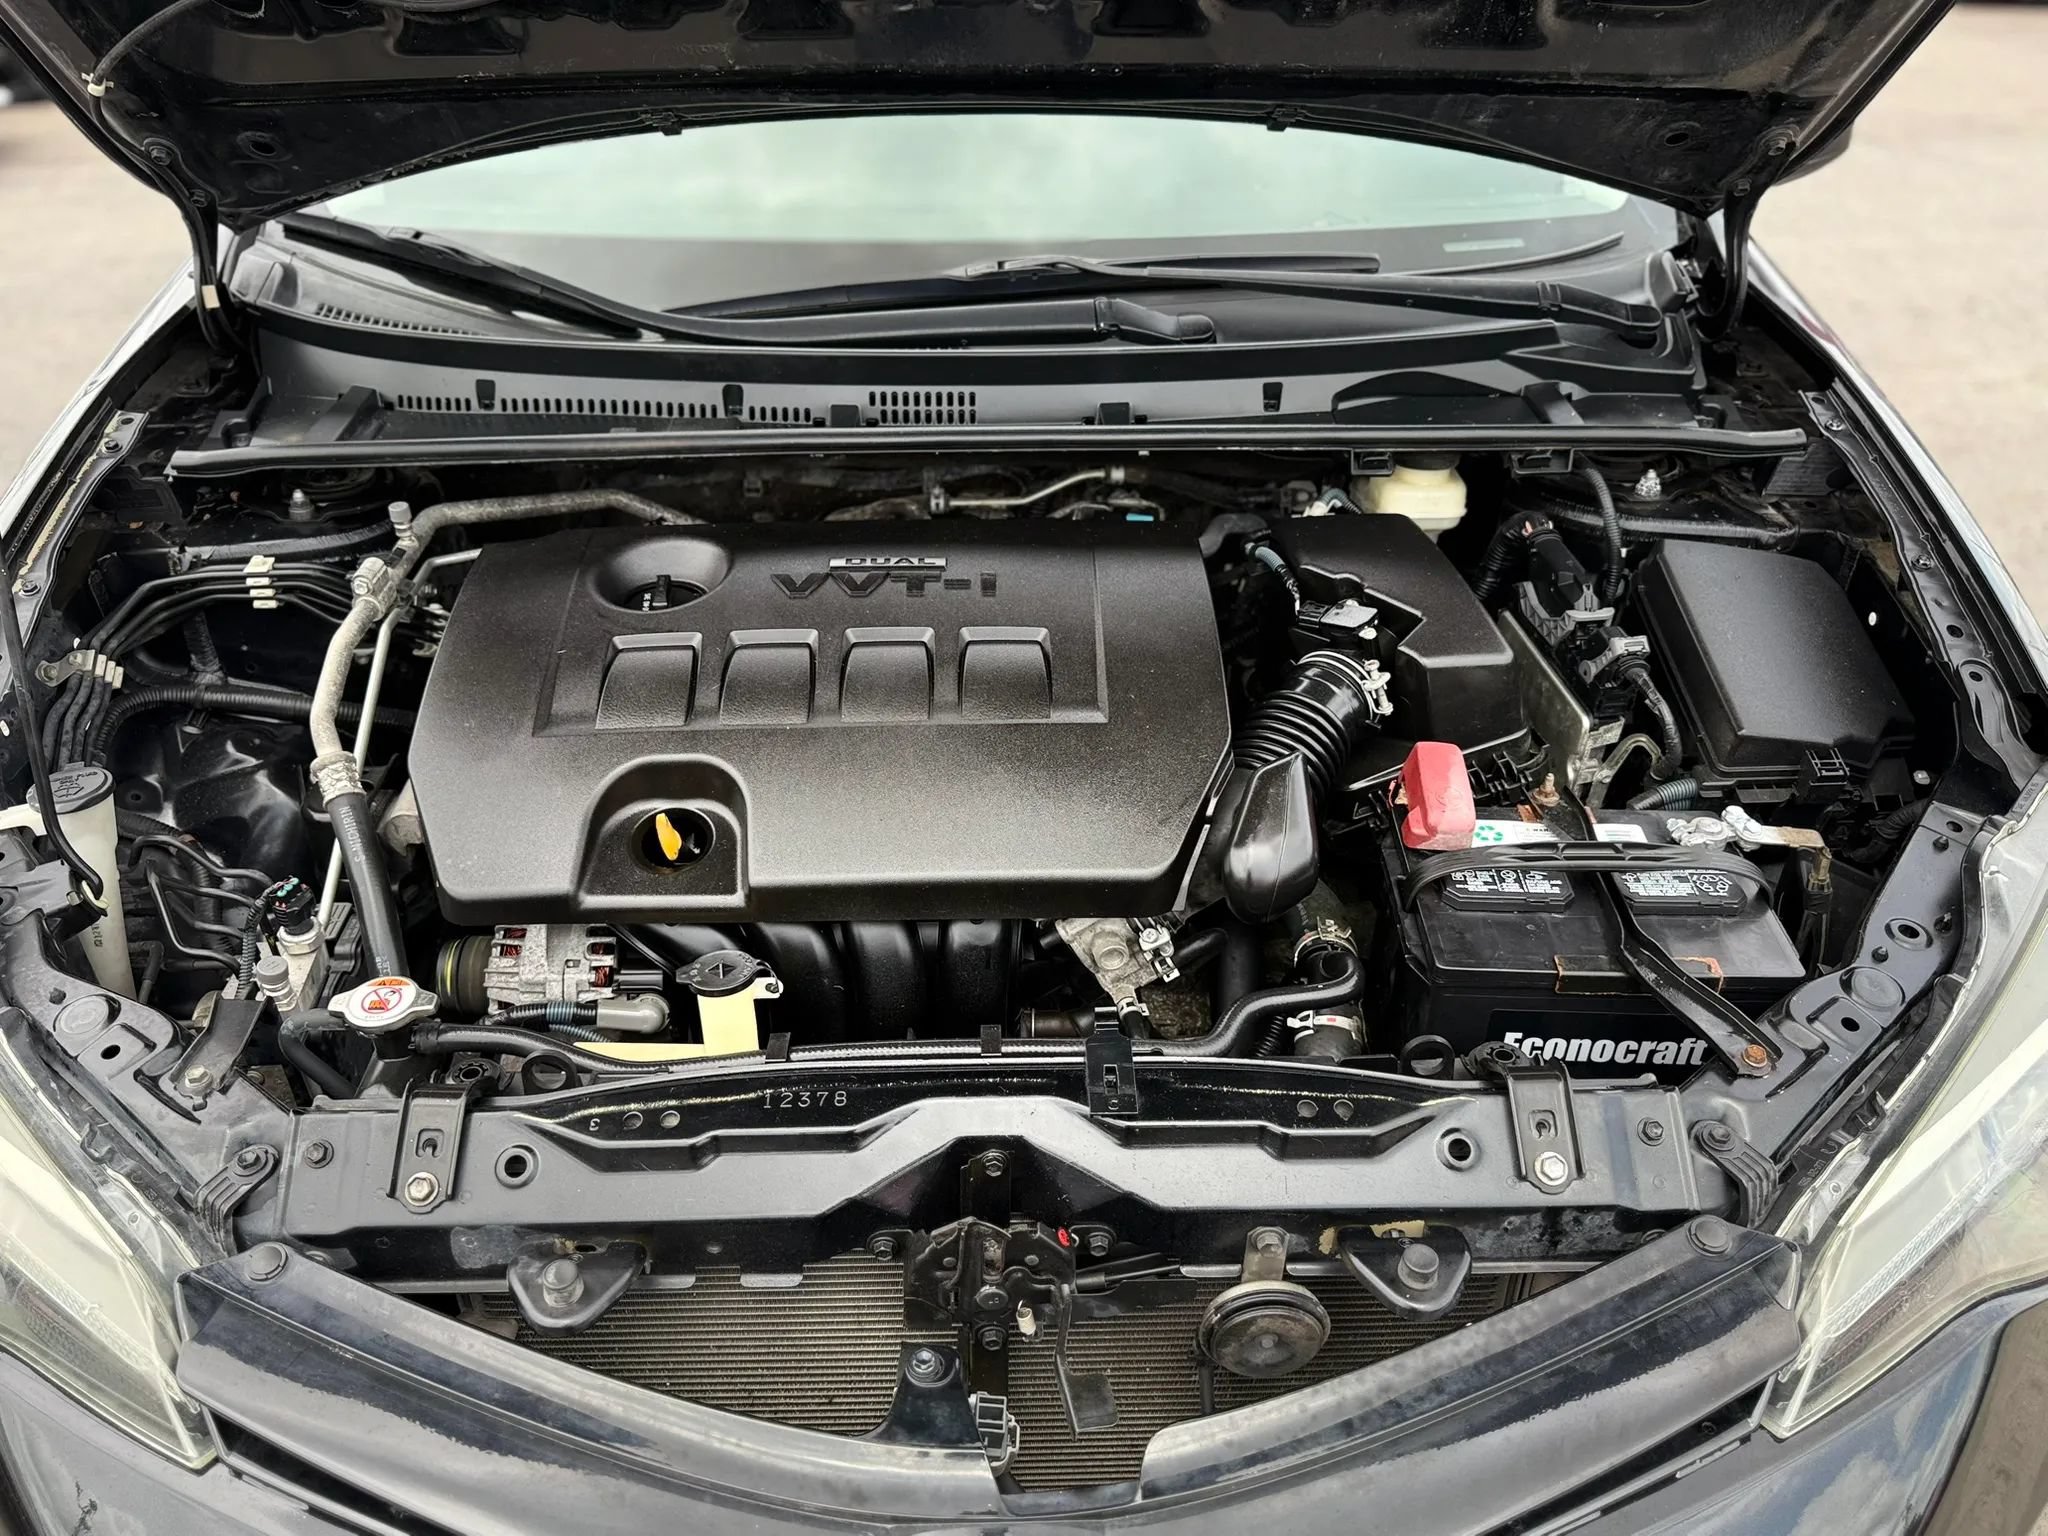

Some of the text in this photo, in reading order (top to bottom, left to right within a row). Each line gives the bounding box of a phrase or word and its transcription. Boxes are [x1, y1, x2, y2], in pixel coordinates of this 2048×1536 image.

[844, 557, 937, 566] DUAL
[1503, 1031, 1709, 1066] Econocraft
[763, 1090, 848, 1109] 12378
